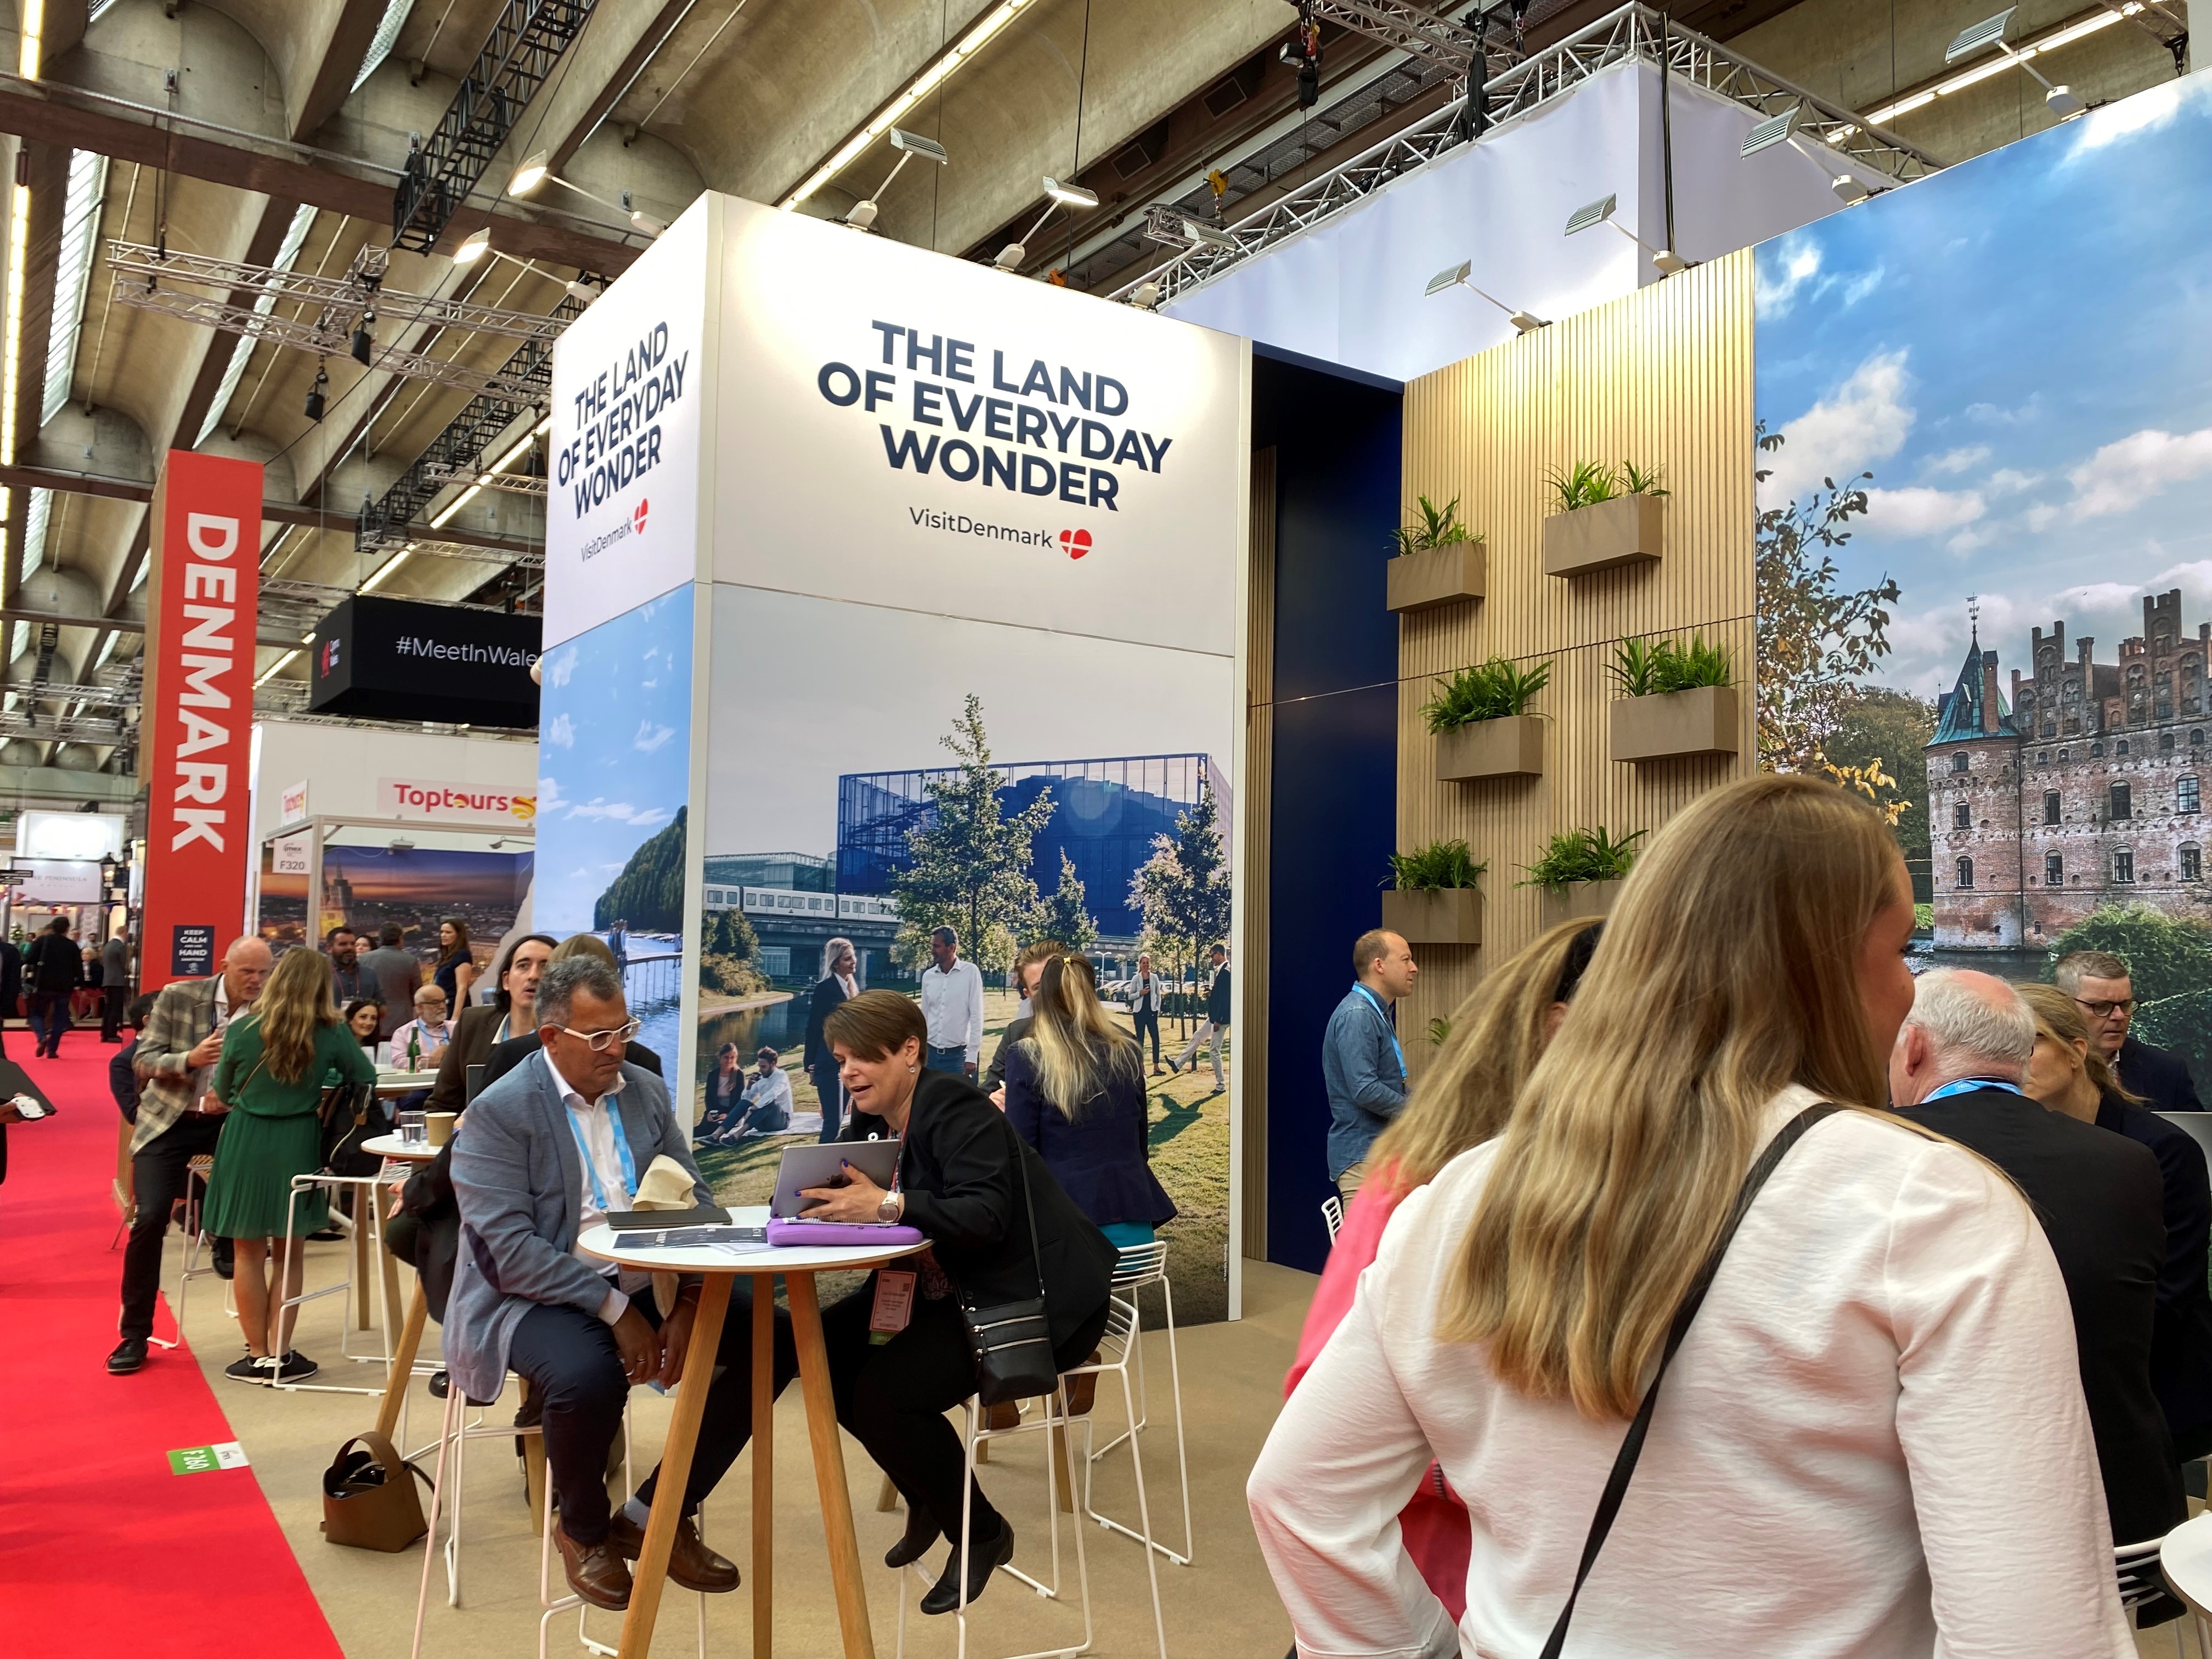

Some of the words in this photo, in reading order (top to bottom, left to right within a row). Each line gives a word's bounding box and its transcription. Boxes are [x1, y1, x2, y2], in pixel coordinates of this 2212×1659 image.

[574, 370, 607, 431] THE
[613, 321, 669, 402] LAND
[872, 320, 974, 384] THE
[993, 349, 1128, 417] LAND
[558, 437, 582, 488] OF
[584, 349, 689, 470] EVERYDAY
[817, 362, 895, 413] OF
[913, 380, 1172, 474] EVERYDAY
[574, 424, 661, 520] WONDER
[879, 424, 1119, 512] WONDER
[580, 517, 633, 562] VisitDenmark
[909, 506, 1053, 549] VisitDenmark
[171, 512, 239, 853] DENMARK
[395, 635, 538, 668] #MeetInWale
[393, 785, 509, 812] Toptours
[280, 860, 305, 870] F320
[181, 1449, 210, 1470] F260
